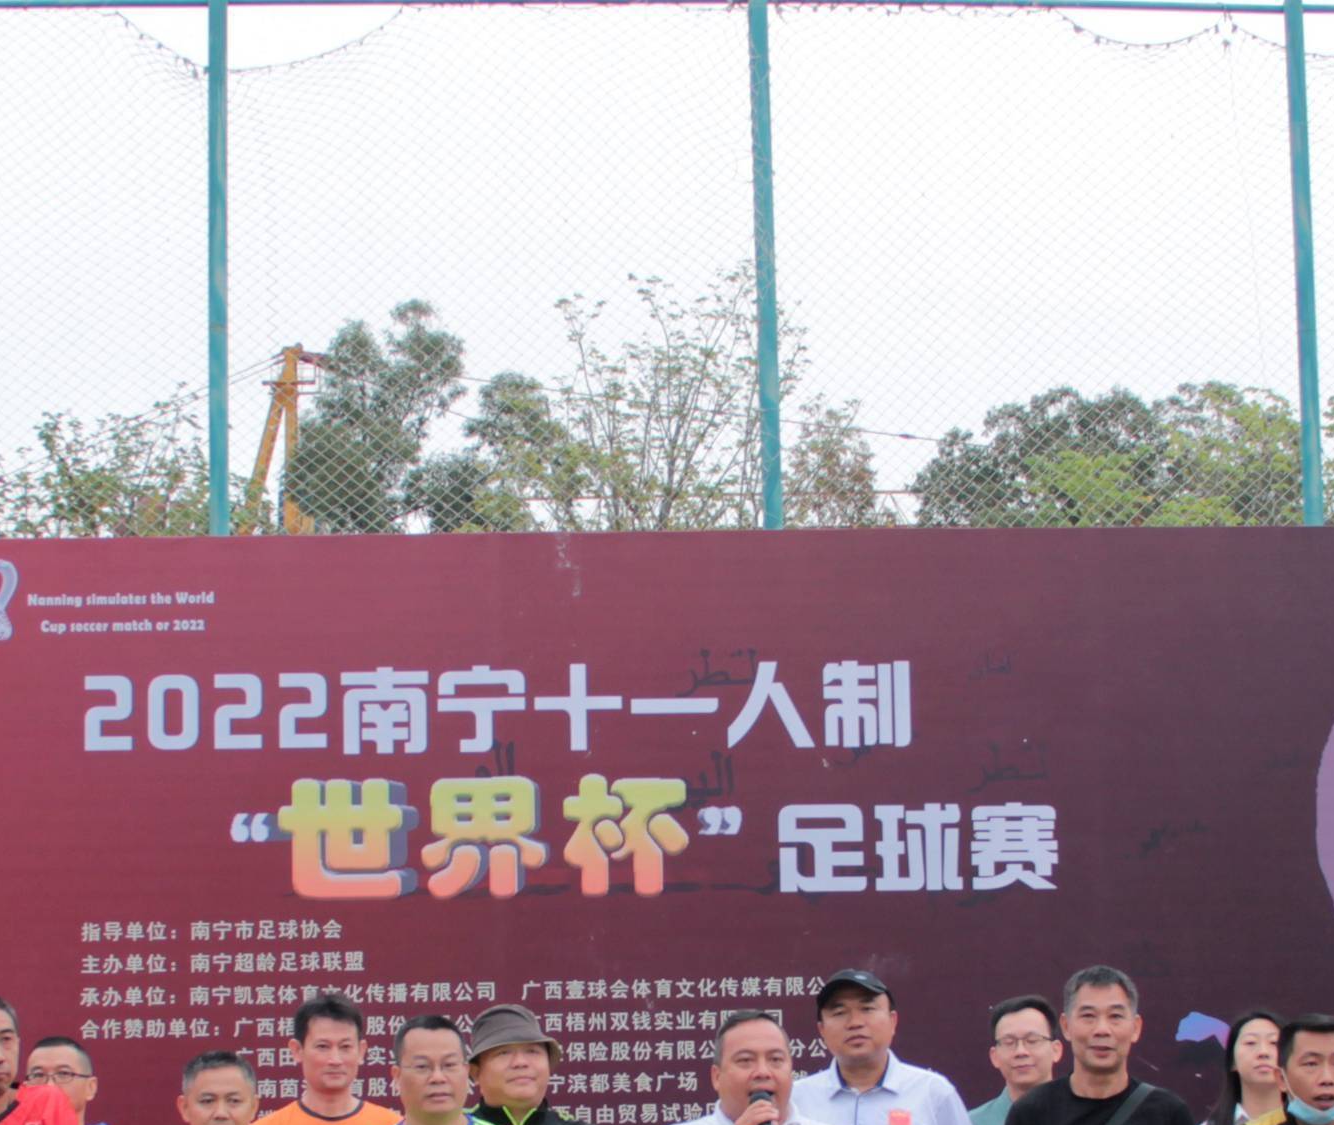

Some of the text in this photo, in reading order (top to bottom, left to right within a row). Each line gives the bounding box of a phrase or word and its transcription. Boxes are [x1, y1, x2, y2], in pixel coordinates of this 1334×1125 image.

[27, 592, 215, 607] Nanning simulates the World
[41, 620, 66, 634] Cup
[70, 620, 109, 632] soccer
[112, 619, 152, 631] match
[173, 619, 205, 631] 2022
[83, 659, 912, 756] 2022南宁十一人制
[81, 920, 343, 941] 指导单位：南宁市足球协会
[80, 951, 366, 974] 主办单位：南宁超龄足球联盟
